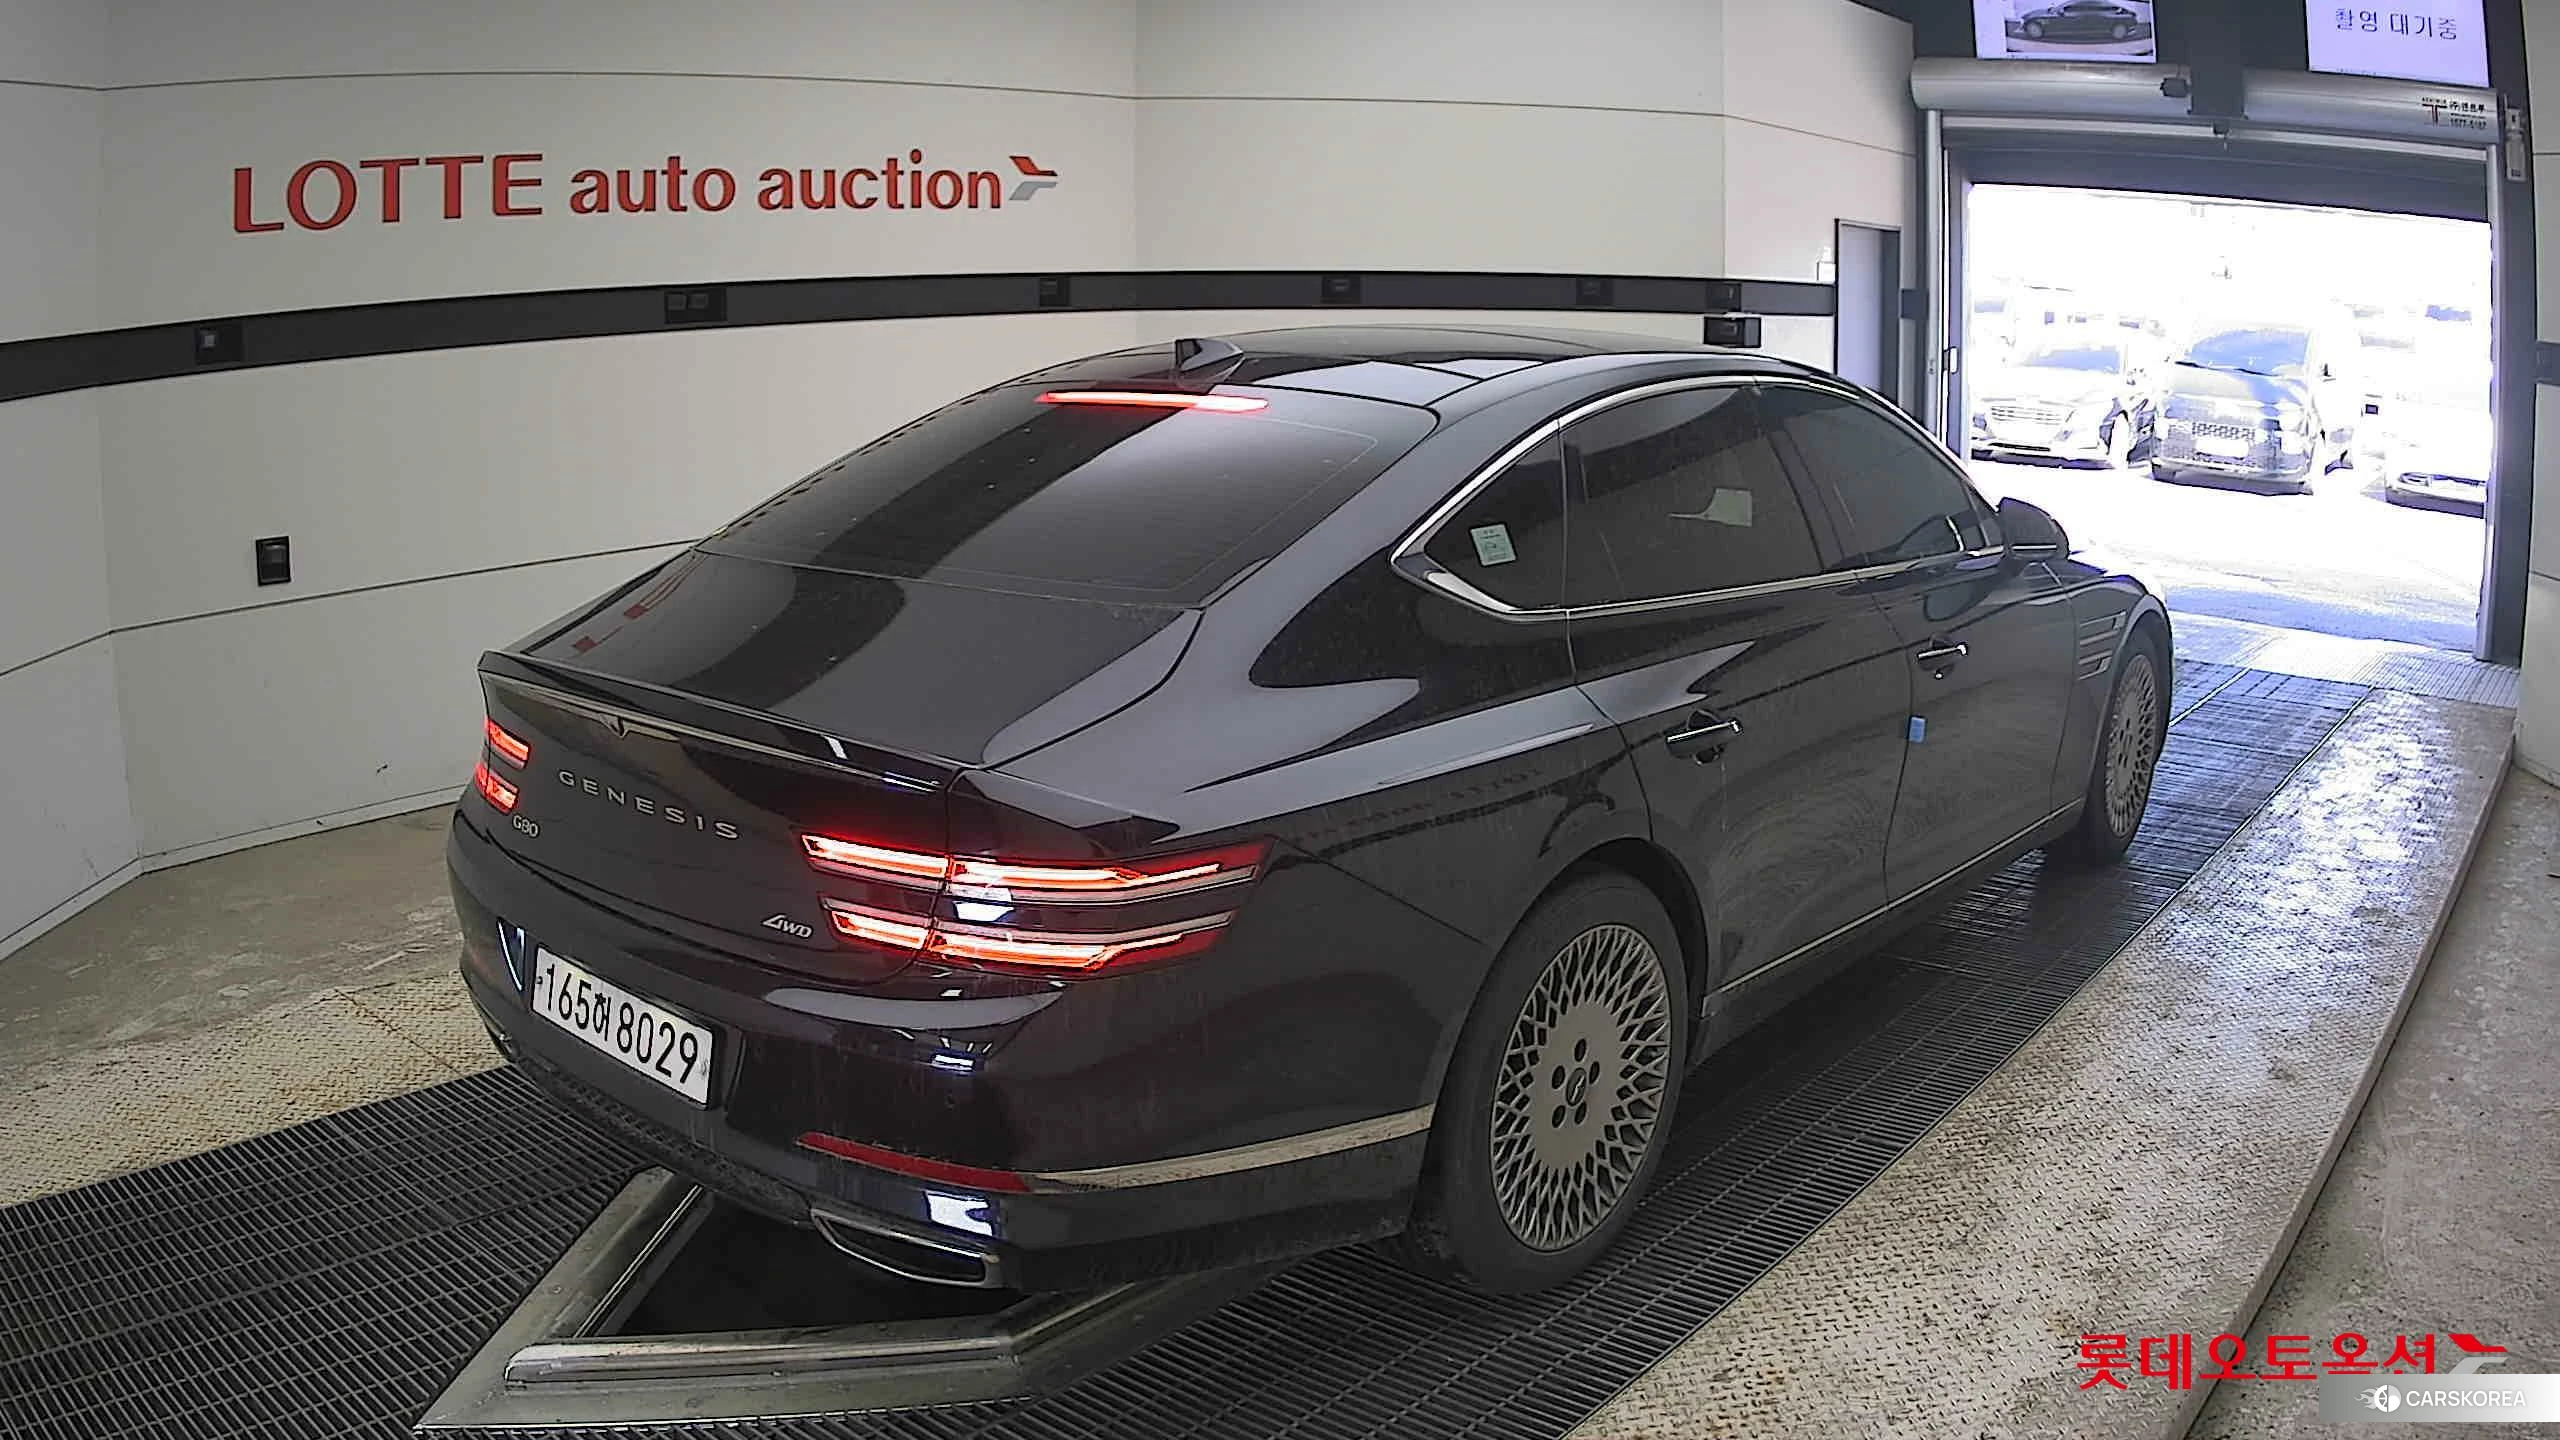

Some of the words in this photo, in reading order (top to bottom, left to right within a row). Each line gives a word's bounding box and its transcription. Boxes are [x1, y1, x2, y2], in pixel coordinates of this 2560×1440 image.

[2390, 12, 2457, 40] 대기중
[234, 153, 543, 233] LOTTE
[569, 156, 736, 214] auto
[757, 148, 1001, 211] auction
[512, 814, 539, 837] G80
[558, 769, 740, 840] GENESIS
